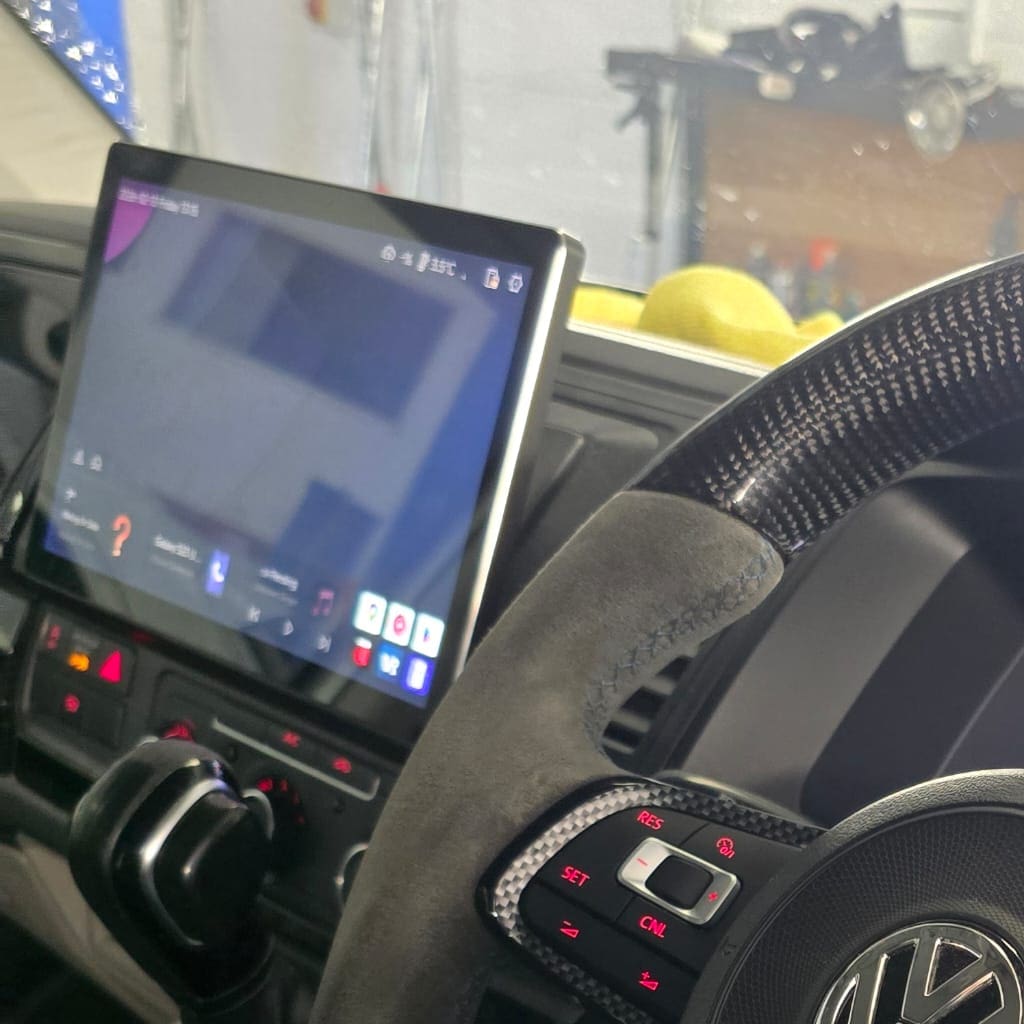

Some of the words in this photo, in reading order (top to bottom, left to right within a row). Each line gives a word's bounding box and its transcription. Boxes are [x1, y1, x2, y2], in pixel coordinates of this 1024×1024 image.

[636, 810, 665, 831] RES
[561, 866, 590, 887] SET
[639, 915, 667, 938] CNL
